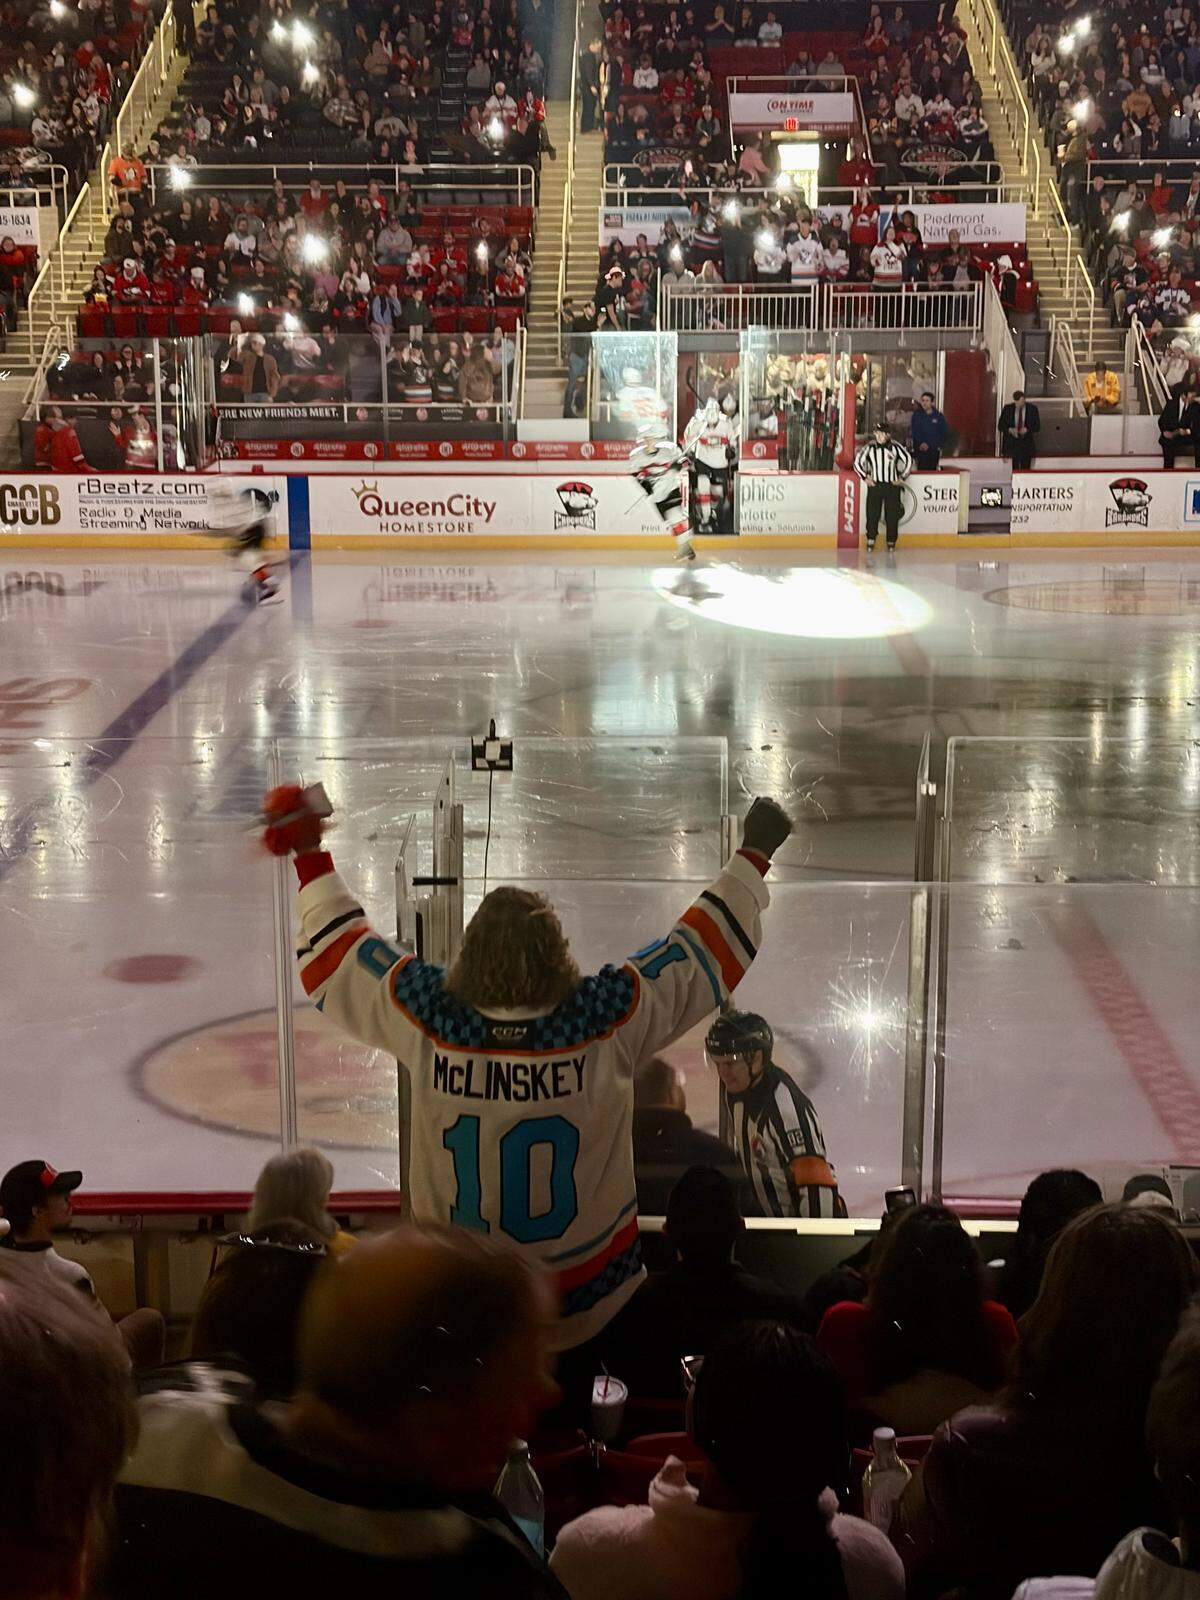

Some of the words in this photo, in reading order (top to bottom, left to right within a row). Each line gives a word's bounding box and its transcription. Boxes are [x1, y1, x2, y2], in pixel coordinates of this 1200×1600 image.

[923, 212, 985, 225] Piedmont
[923, 225, 969, 237] Natal
[240, 407, 262, 418] NEW
[264, 407, 307, 418] FRIENDS
[309, 406, 339, 418] MEET.
[78, 478, 206, 495] rBeatz.com
[741, 478, 785, 506] phics
[1011, 487, 1074, 500] HARTERS
[0, 483, 61, 526] CCB
[359, 494, 497, 523] QueenCity
[844, 479, 855, 534] CCM
[923, 505, 948, 513] YOUR
[79, 507, 116, 518] Radio
[143, 507, 182, 518] Media
[80, 518, 147, 530] Streaming
[379, 522, 475, 533] HOMESTORE
[492, 1026, 528, 1036] CCM
[434, 1052, 586, 1102] McLINSKEY
[443, 1113, 580, 1244] 10
